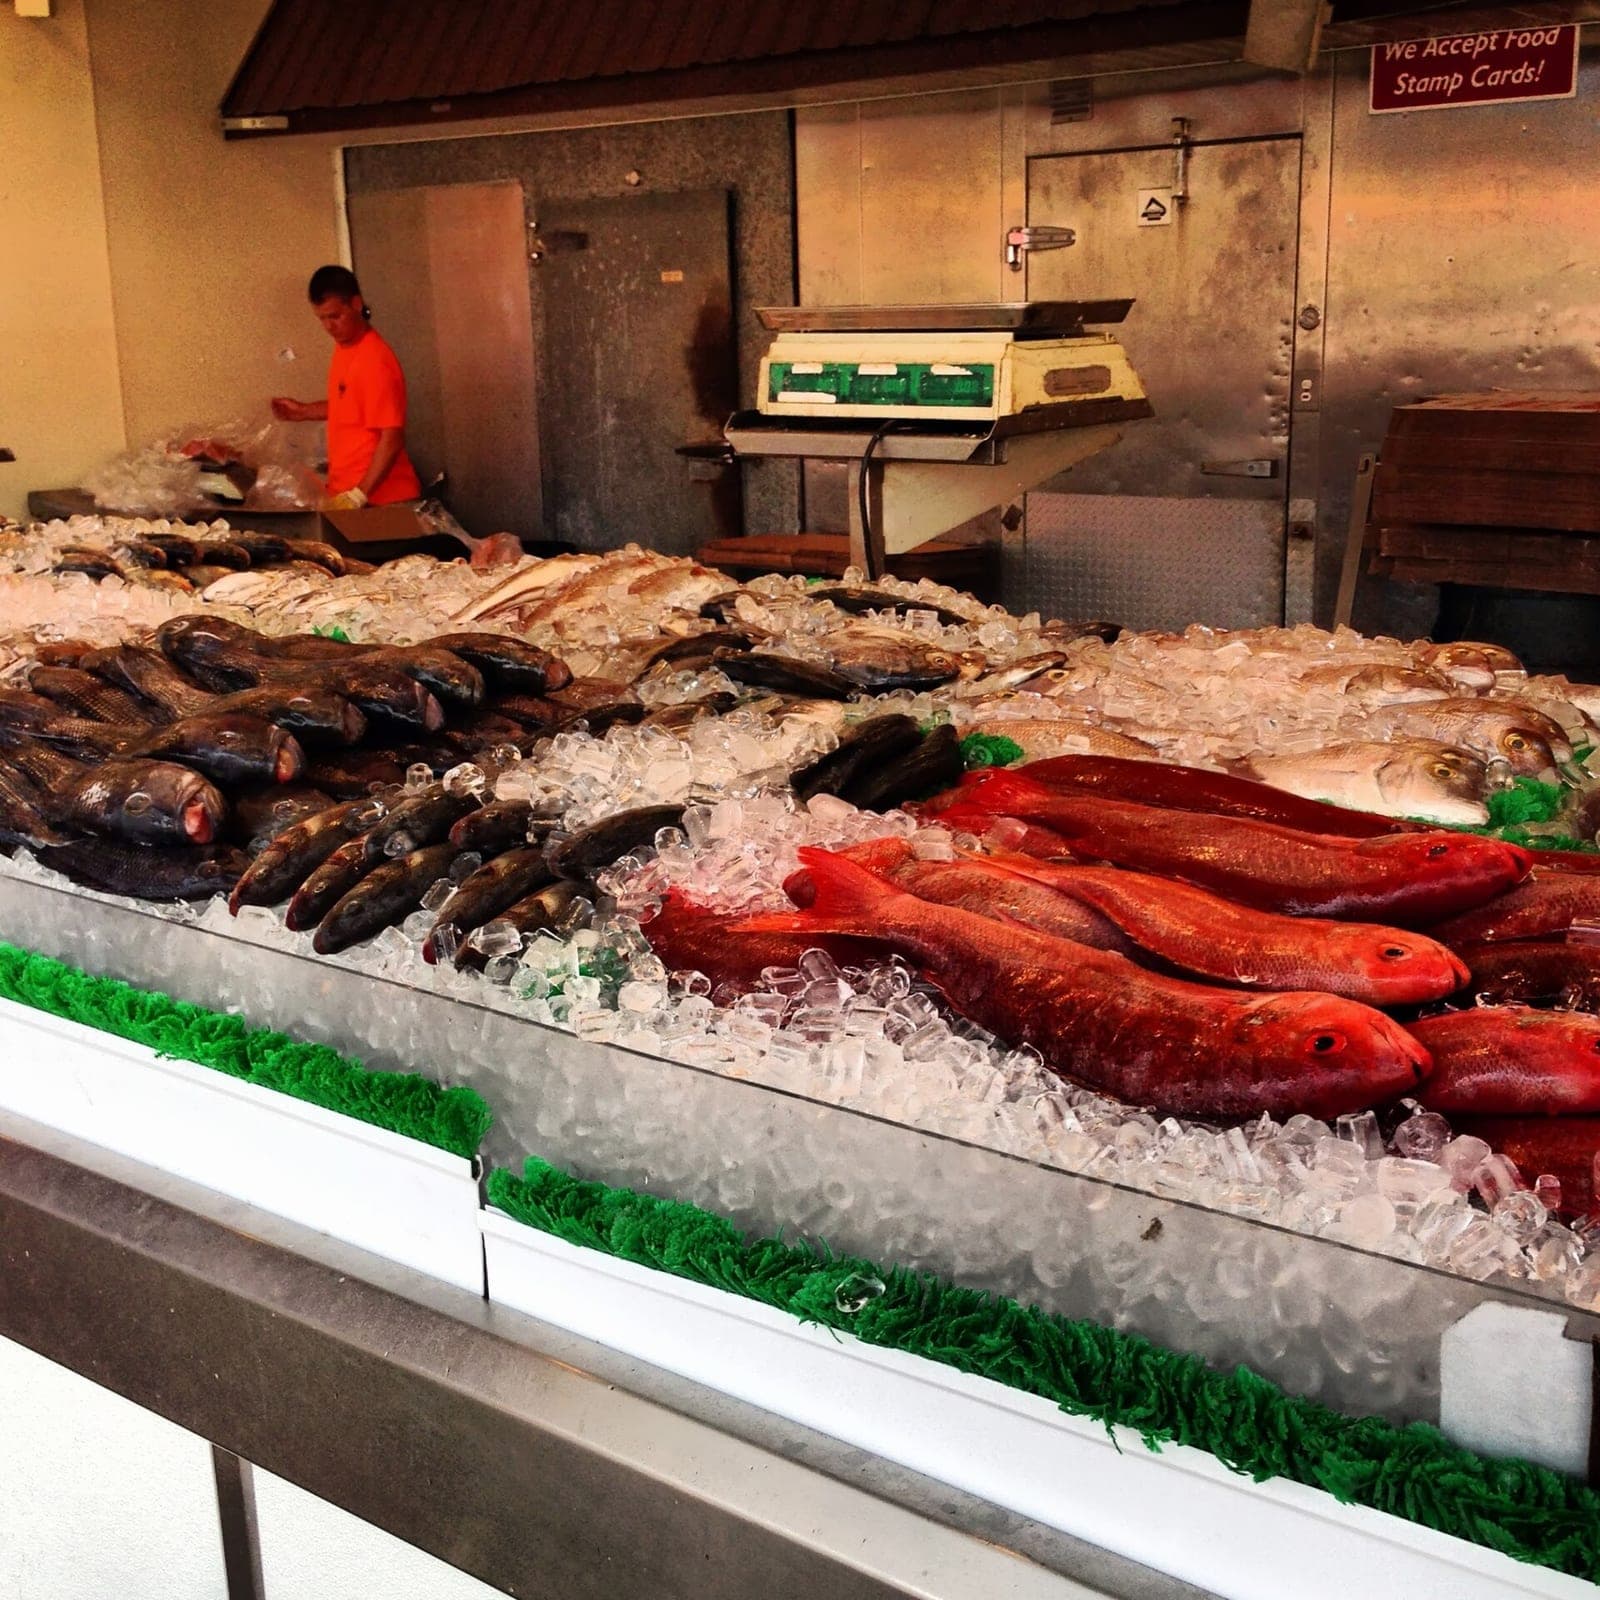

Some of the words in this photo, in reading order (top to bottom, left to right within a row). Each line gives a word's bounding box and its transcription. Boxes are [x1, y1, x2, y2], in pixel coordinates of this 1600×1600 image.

[1385, 42, 1417, 60] We
[1422, 32, 1498, 59] Accept
[1504, 27, 1560, 49] Food
[1394, 72, 1463, 96] Stamp
[1471, 60, 1545, 87] Cards!
